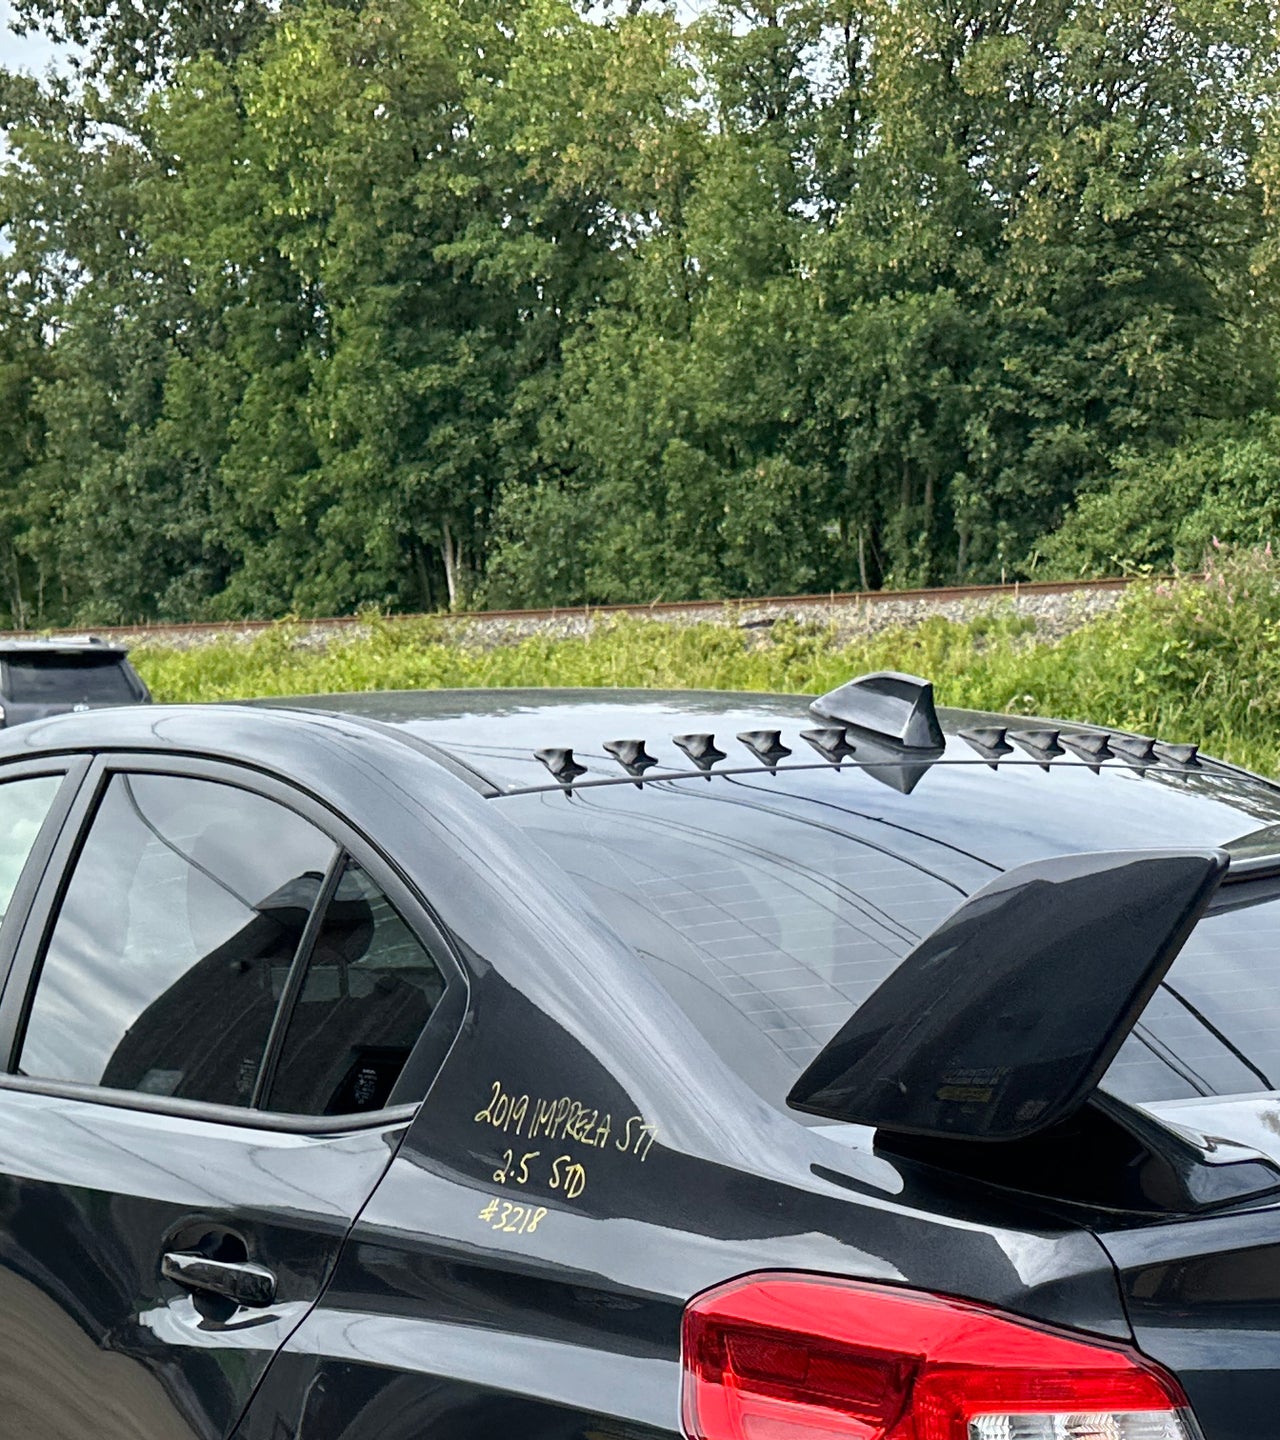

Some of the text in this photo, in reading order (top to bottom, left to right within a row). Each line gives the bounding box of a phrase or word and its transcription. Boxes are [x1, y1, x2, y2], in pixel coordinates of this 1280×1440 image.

[474, 1080, 660, 1162] 2019 IMPREZA STI
[492, 1148, 587, 1199] 2.5 STD
[477, 1197, 548, 1235] #3218
